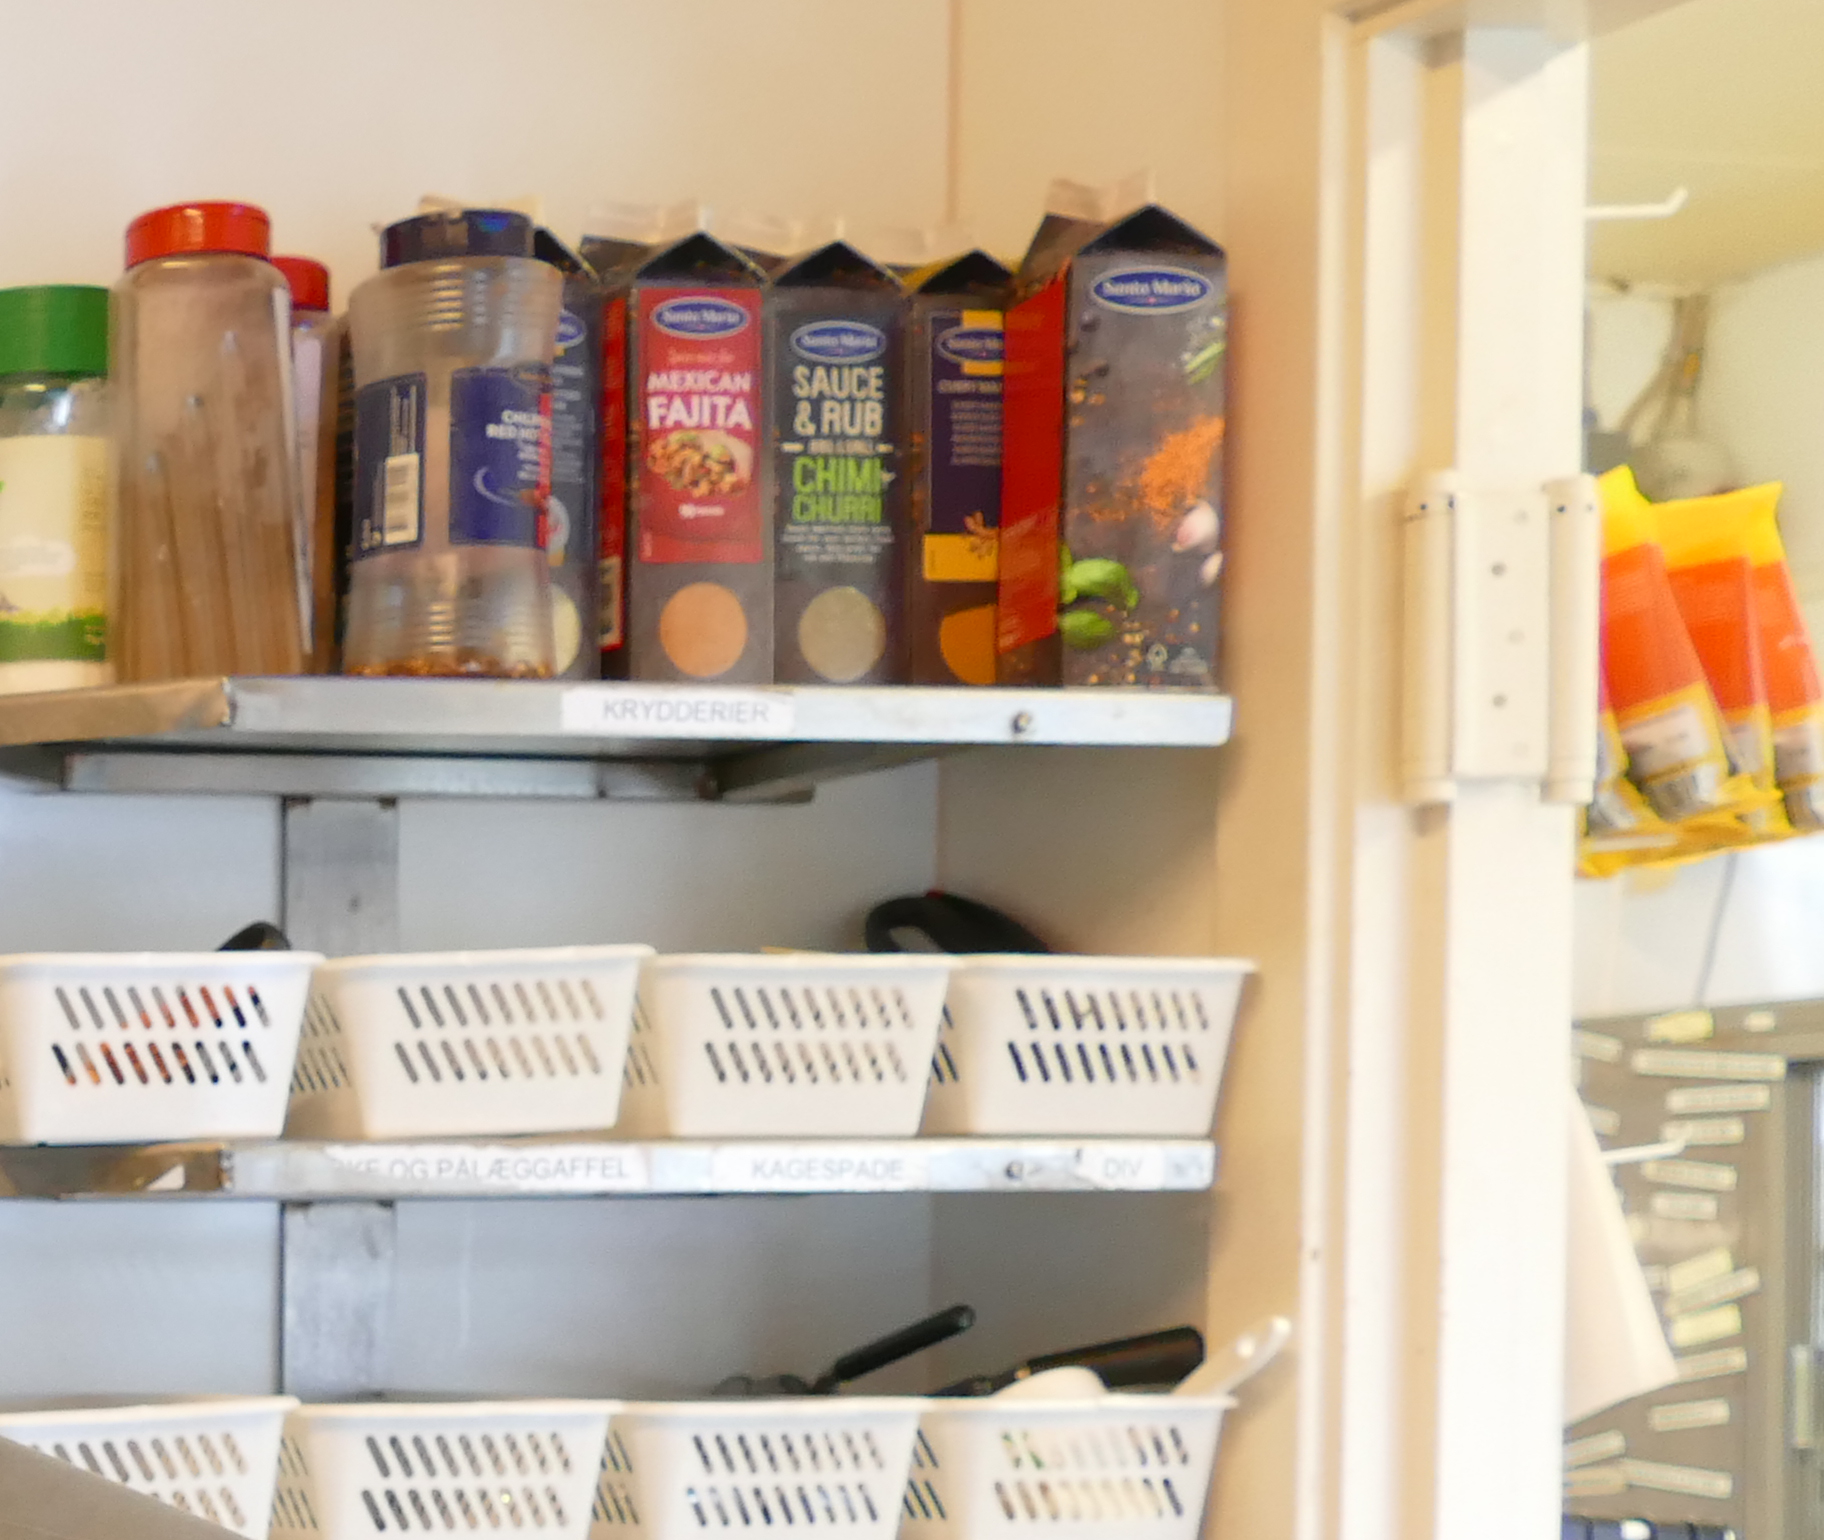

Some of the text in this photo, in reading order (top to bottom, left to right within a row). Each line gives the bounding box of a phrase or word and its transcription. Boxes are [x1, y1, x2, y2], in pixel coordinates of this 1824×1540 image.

[647, 370, 752, 392] MEXICAN
[793, 365, 884, 399] SAUCE
[647, 394, 753, 430] FAJITA
[794, 400, 883, 436] & RUB
[793, 456, 882, 493] CHIMI
[793, 494, 882, 523] CHURRI
[603, 698, 770, 723] KRYDDERIER
[388, 1157, 429, 1181] OG
[753, 1158, 905, 1181] KAGESPADE
[1103, 1157, 1143, 1179] DIV
